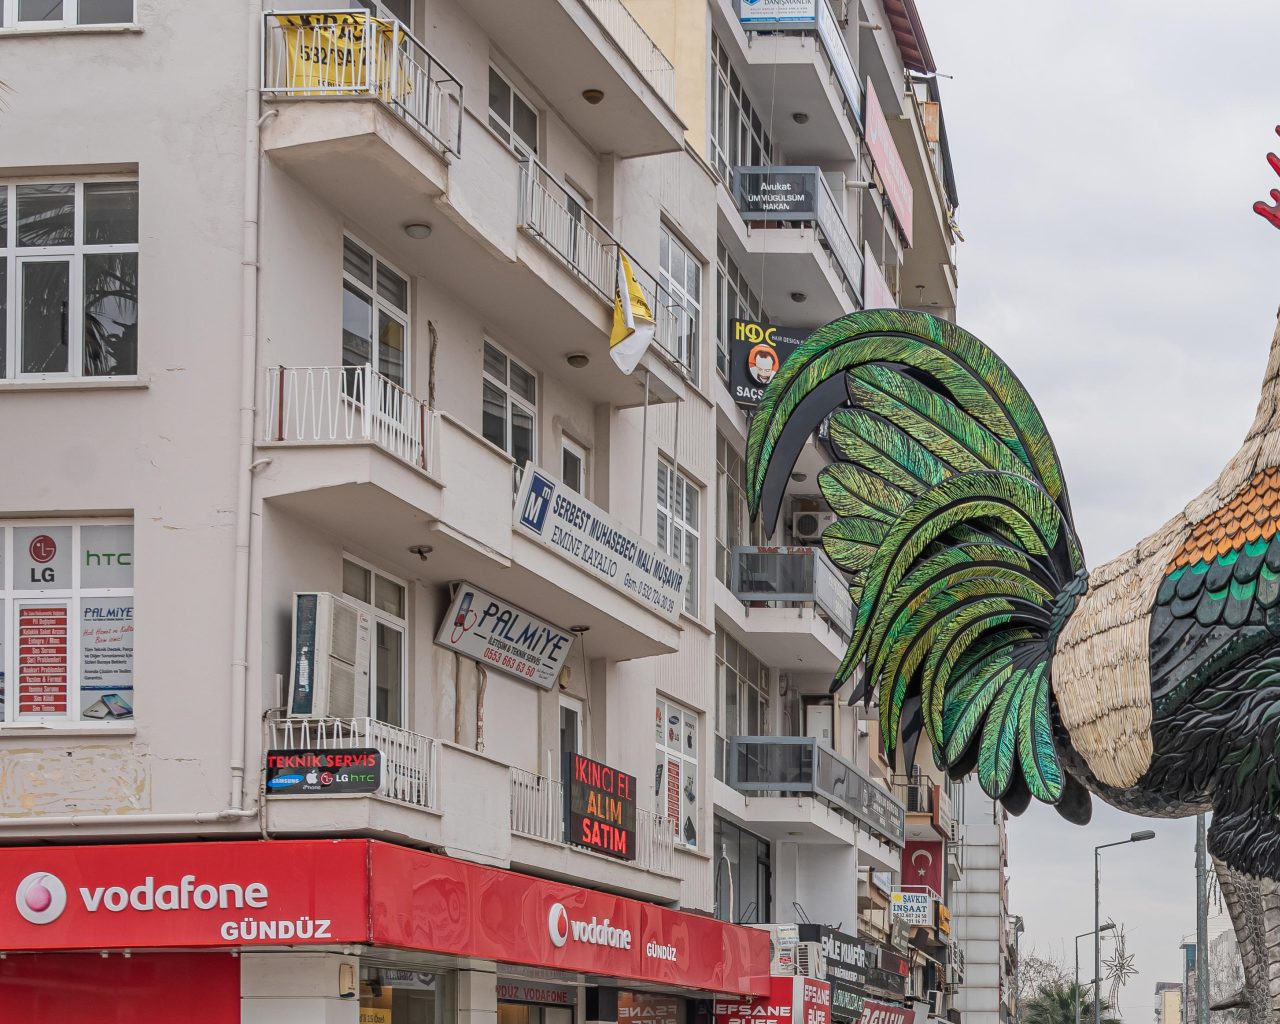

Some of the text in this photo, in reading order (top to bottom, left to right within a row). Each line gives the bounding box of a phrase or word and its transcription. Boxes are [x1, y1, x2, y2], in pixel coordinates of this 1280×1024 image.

[760, 182, 791, 191] Avukat
[736, 386, 764, 400] SAÇS
[551, 525, 583, 556] EMİNE
[553, 494, 683, 593] SERBEST MUHASEBECİ MALİ MÜŞAVİR
[31, 567, 55, 583] LG
[484, 647, 502, 663] 0553
[502, 656, 514, 669] 663
[515, 662, 524, 673] 63
[525, 666, 536, 678] 50
[268, 752, 376, 768] TEKNİK SERVİS
[336, 774, 348, 782] LG
[617, 773, 632, 801] EL
[587, 790, 622, 825] ALIM
[582, 817, 627, 855] SATIM
[79, 875, 269, 912] vodafone
[893, 903, 927, 914] İNŞAAT
[220, 916, 332, 941] GÜNDÜZ
[571, 916, 677, 961] vodafone GÜNDÜZ
[524, 988, 567, 1002] VODAFONE
[804, 985, 829, 1006] EFSANE
[716, 1005, 791, 1016] EFSANE
